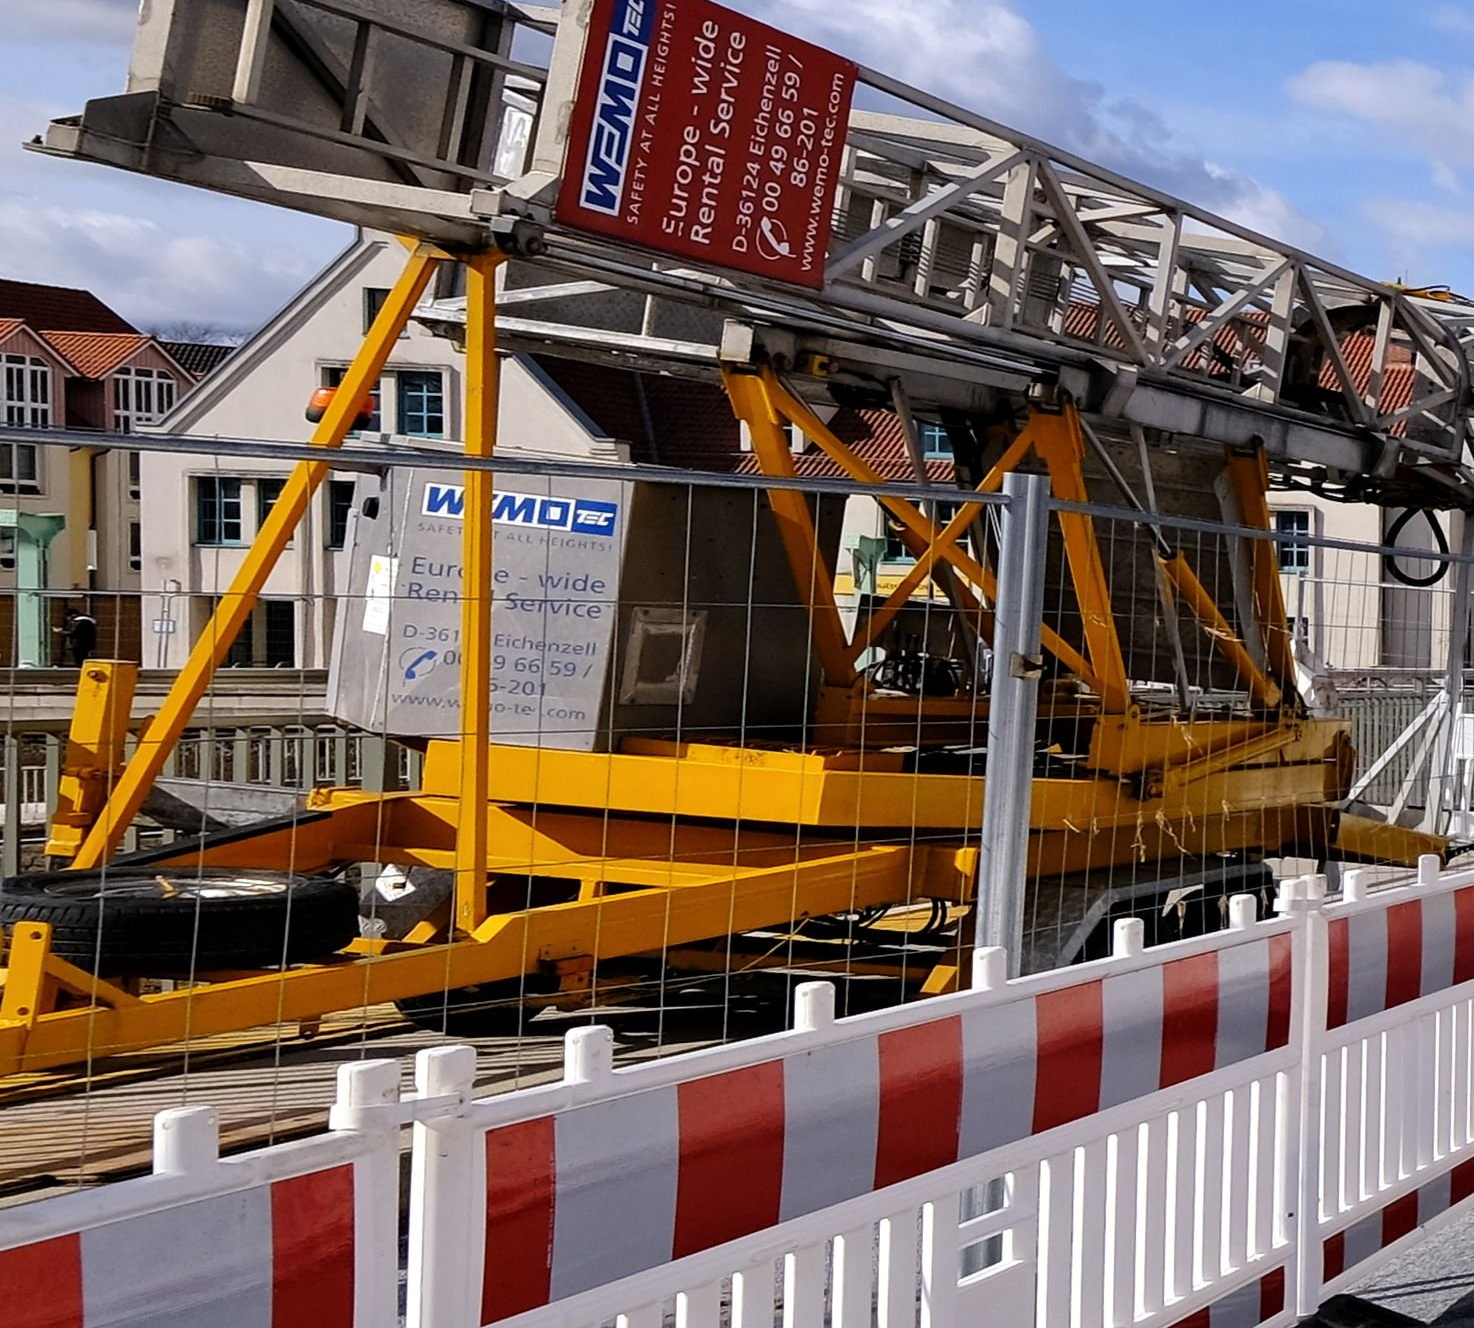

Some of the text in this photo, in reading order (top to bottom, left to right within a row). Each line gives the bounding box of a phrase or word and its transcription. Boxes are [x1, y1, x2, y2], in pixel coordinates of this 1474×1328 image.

[781, 71, 801, 102] 59
[583, 39, 644, 211] WEMO
[644, 93, 660, 126] ALL
[775, 107, 794, 139] 66
[640, 129, 654, 153] AT
[662, 126, 701, 237] Europe
[691, 20, 719, 94] wide
[690, 31, 746, 245] Rental Service
[731, 44, 782, 252] D-36124 Eichenzell
[769, 145, 788, 176] 49
[790, 107, 819, 188] 86-201
[801, 73, 845, 271] www.wemo-tec.com
[626, 158, 648, 225] SAFETY
[762, 182, 781, 212] 00
[426, 486, 615, 528] WMO TEC
[418, 523, 463, 536] SAFET
[538, 572, 606, 594] wide
[504, 592, 602, 619] Service
[403, 624, 597, 656] D-361 Eichenzell
[514, 657, 541, 674] 66
[549, 660, 577, 678] 59
